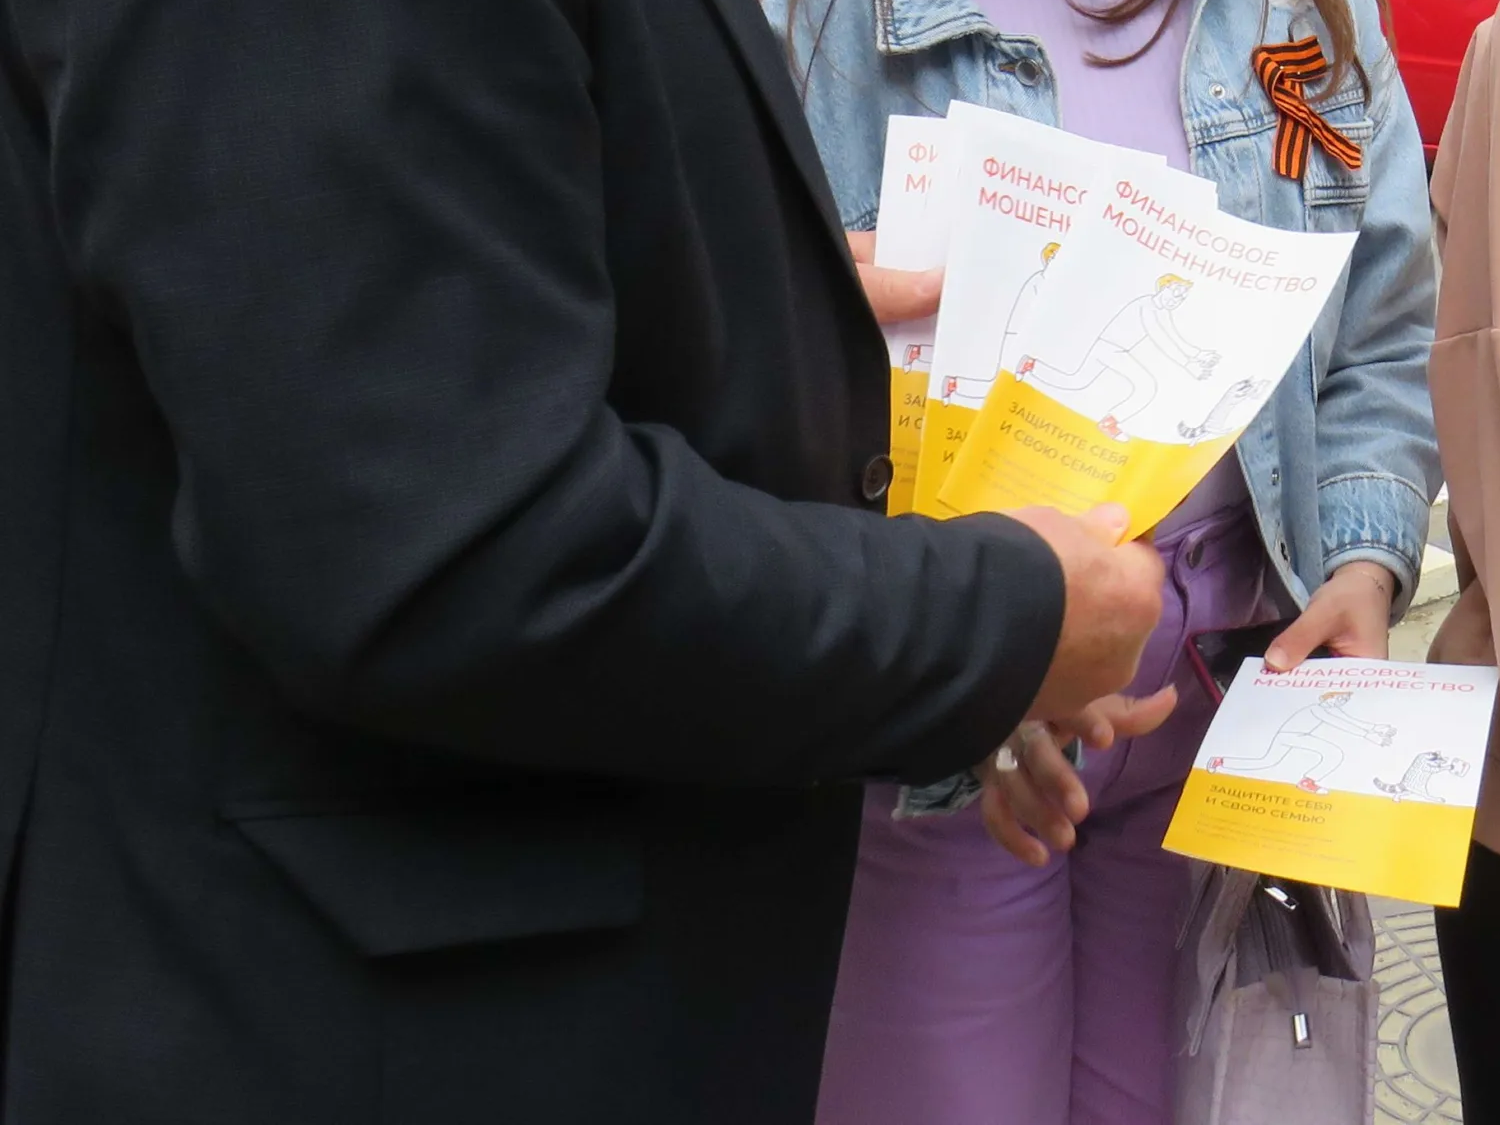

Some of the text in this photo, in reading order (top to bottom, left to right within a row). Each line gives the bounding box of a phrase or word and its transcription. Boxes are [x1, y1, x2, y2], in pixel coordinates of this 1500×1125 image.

[1116, 180, 1279, 267] ФИНАНСОВОЕ
[1102, 203, 1318, 293] МОШЕННИЧЕСТВО
[898, 414, 911, 427] И
[1008, 401, 1129, 467] ЗАЩИТИТЕ СЕБЯ
[1000, 420, 1013, 435] И
[1013, 429, 1058, 460] СВОЮ
[1060, 454, 1117, 483] СЕМЬЮ
[1253, 678, 1475, 692] МОШЕННИЧЕСТВО
[1205, 796, 1326, 824] И СВОЮ СЕМЬЮ
[1210, 784, 1333, 812] ЗАЩИТИТЕ СЕБЯ
